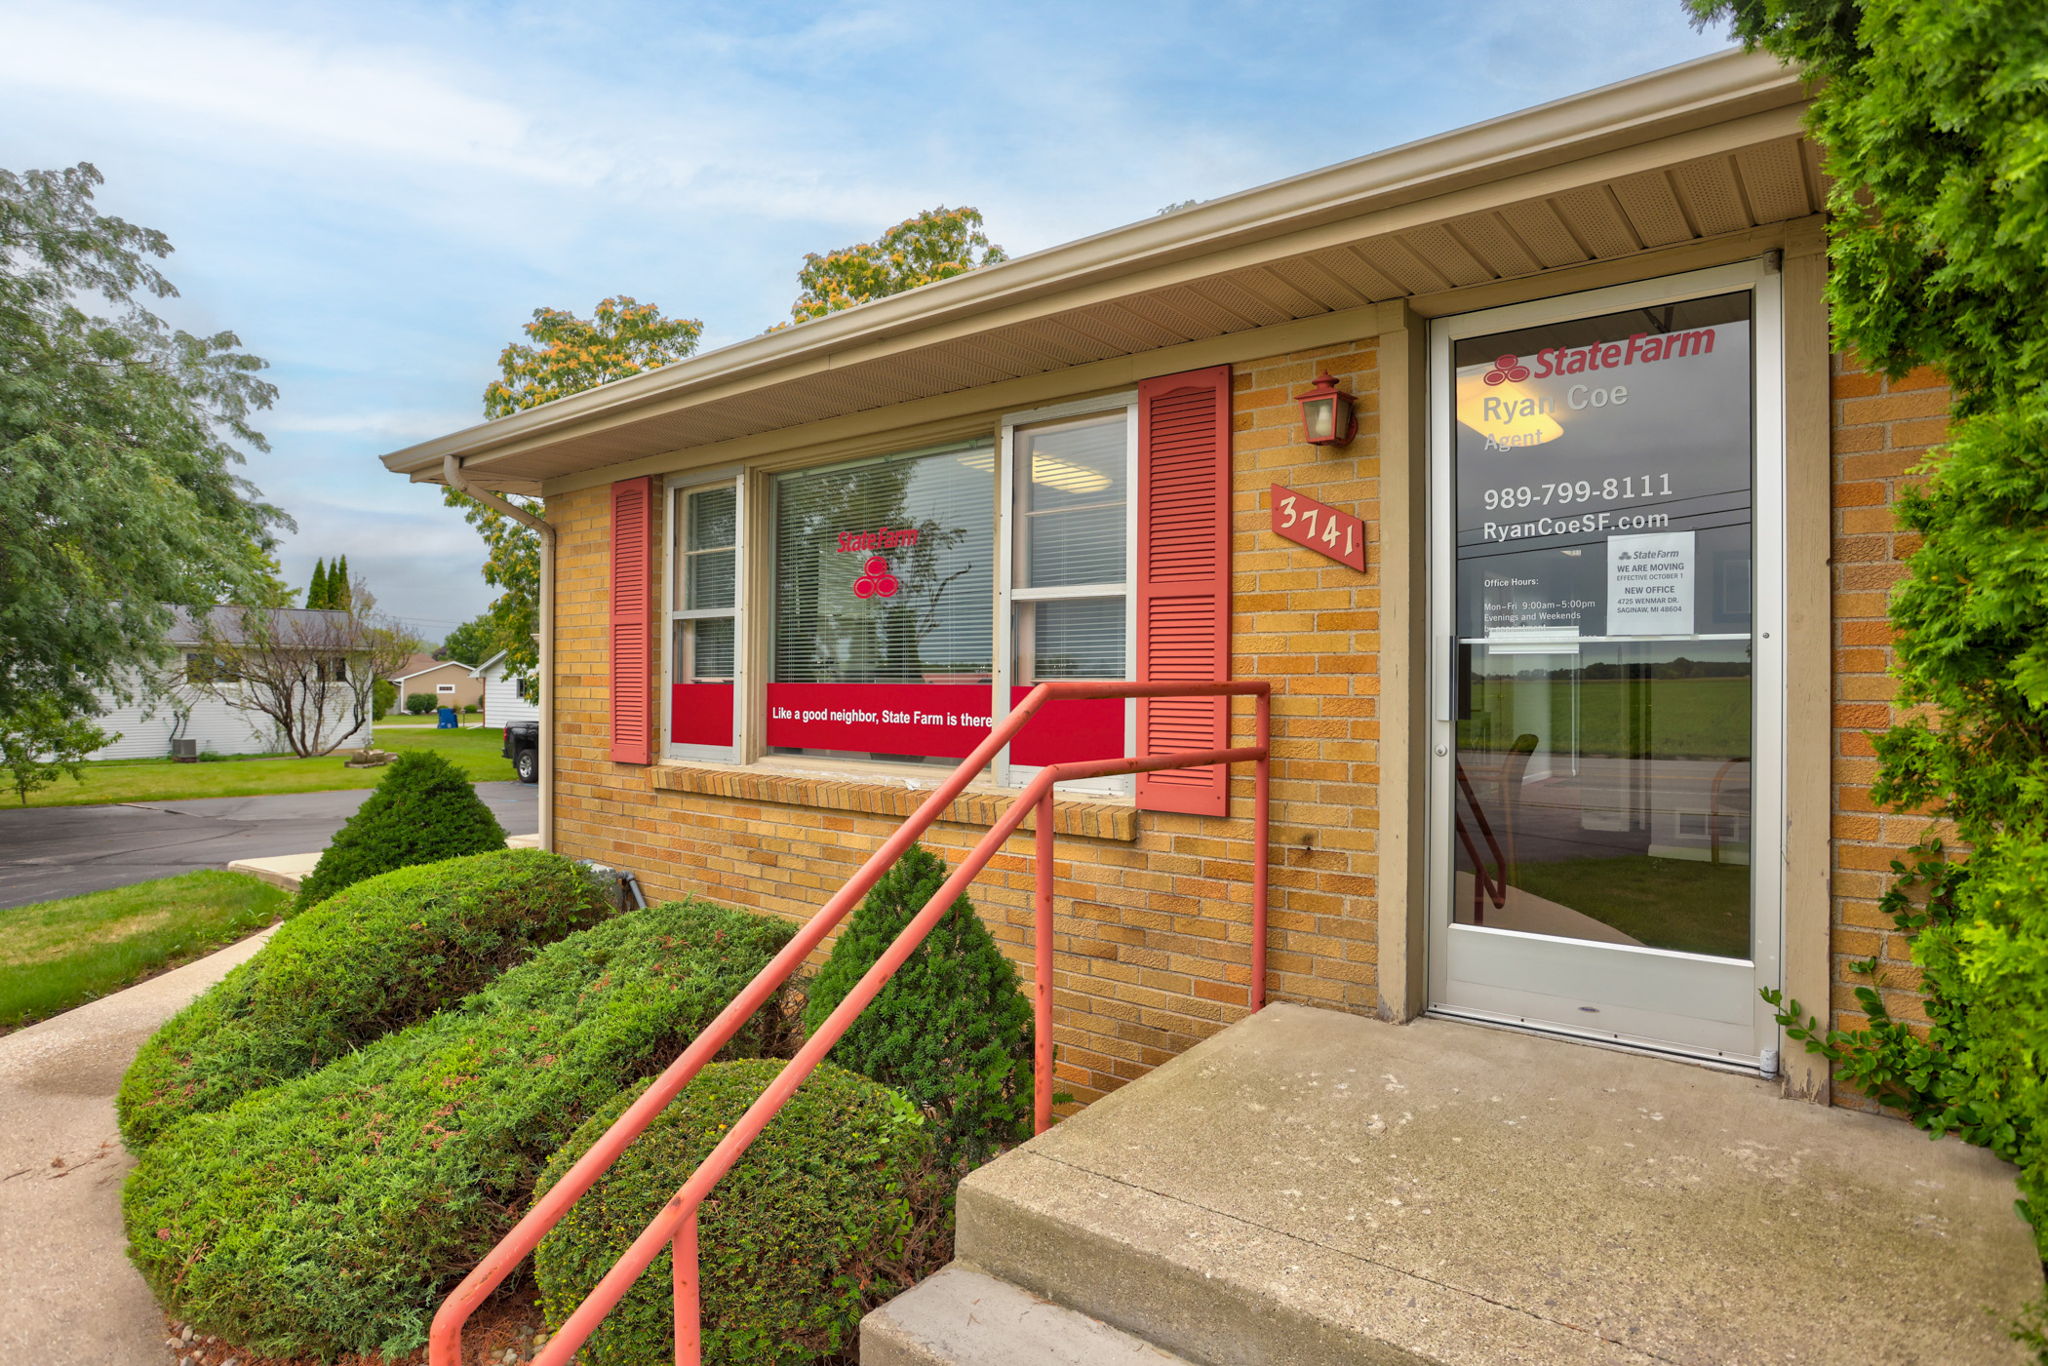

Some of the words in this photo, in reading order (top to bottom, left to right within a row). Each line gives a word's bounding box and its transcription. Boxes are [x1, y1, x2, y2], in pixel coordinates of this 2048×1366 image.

[1483, 395, 1555, 425] Ryan
[1567, 384, 1629, 412] Coe
[1484, 428, 1543, 452] Agent
[1484, 472, 1673, 511] 989-799-8111
[1280, 496, 1353, 557] 3741
[1483, 512, 1669, 542] RyanCoeSF.com
[1617, 565, 1630, 573] WE
[1632, 564, 1648, 572] ARE
[1650, 563, 1685, 571] MOVING
[1484, 579, 1509, 587] Office
[1511, 578, 1539, 586] Hours:
[1646, 586, 1675, 594] OFFICE
[1484, 613, 1519, 622] Evenings
[1521, 612, 1536, 620] and
[1539, 611, 1581, 620] Weekends
[772, 707, 792, 719] Like
[794, 710, 800, 719] a
[802, 708, 828, 723] good
[830, 709, 879, 725] neighbor,
[882, 709, 910, 724] State
[913, 711, 943, 725] Farm
[946, 712, 957, 726] is
[960, 712, 992, 727] there
